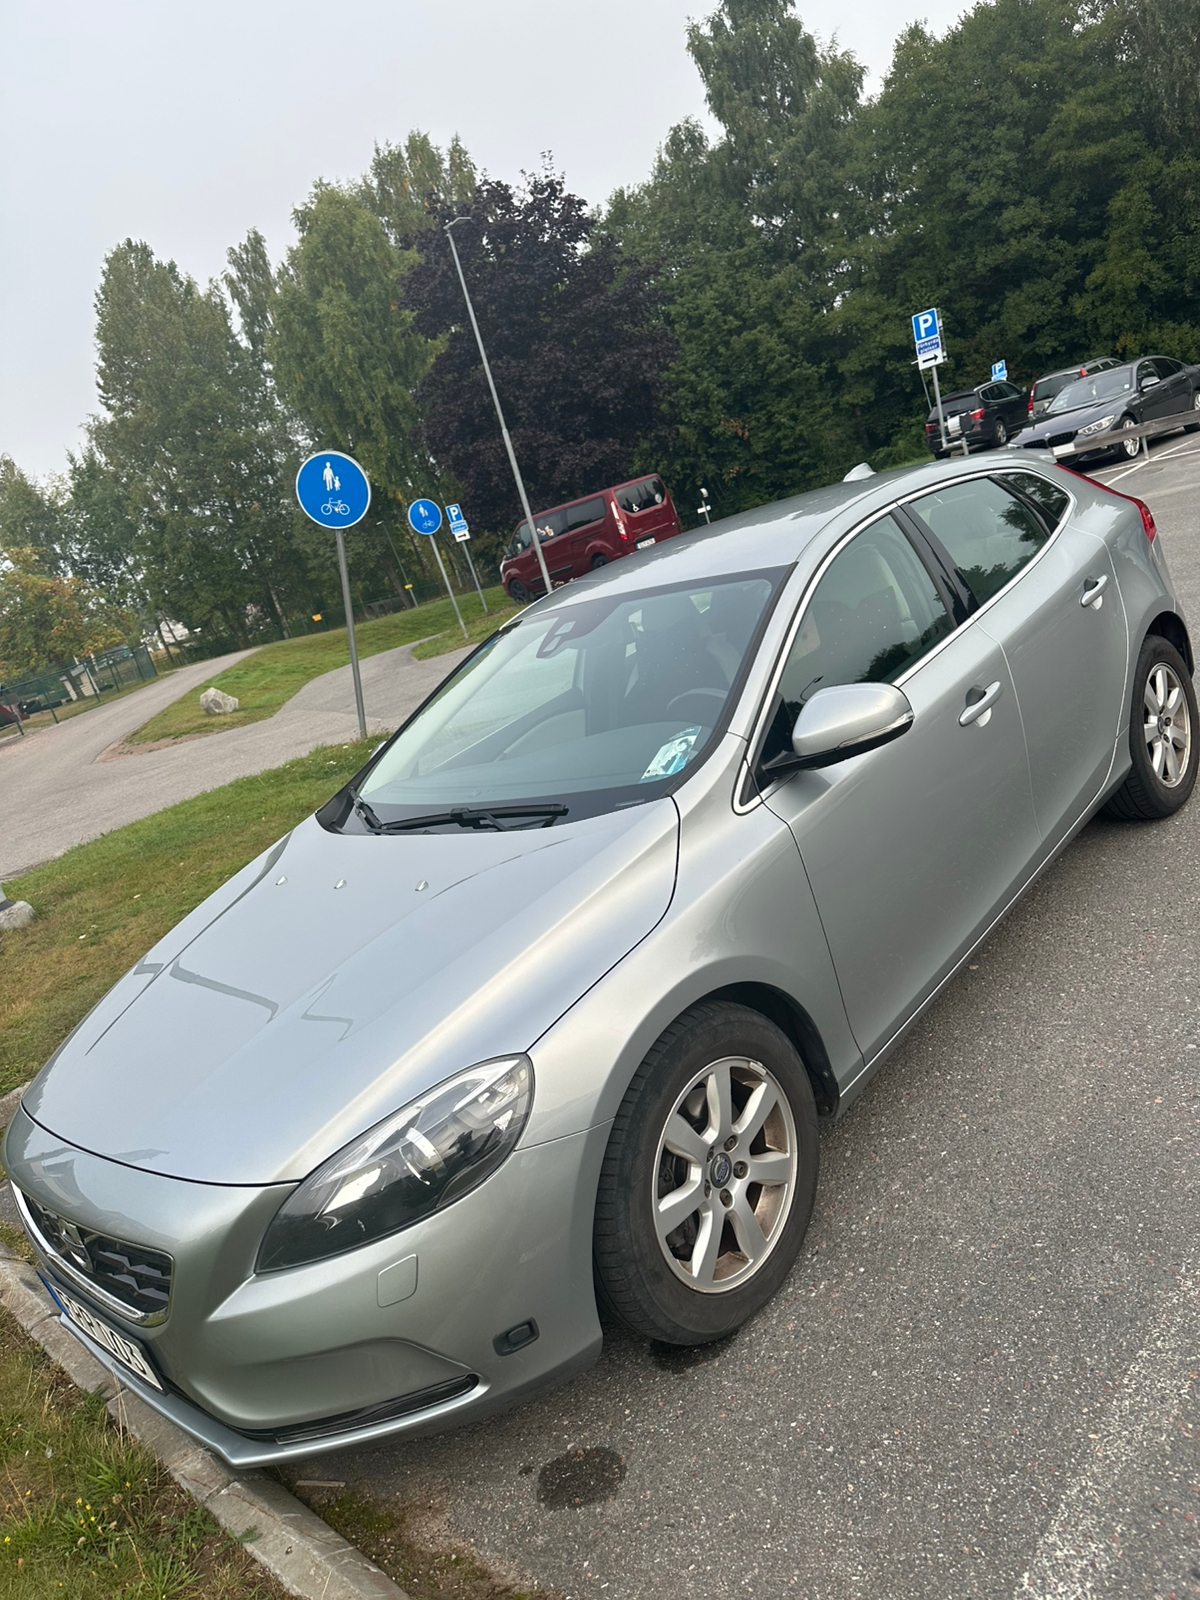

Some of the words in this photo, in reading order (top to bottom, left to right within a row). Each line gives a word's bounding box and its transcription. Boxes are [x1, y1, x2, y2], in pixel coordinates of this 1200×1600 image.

[918, 313, 933, 338] P
[995, 363, 1003, 374] P
[449, 507, 459, 521] P
